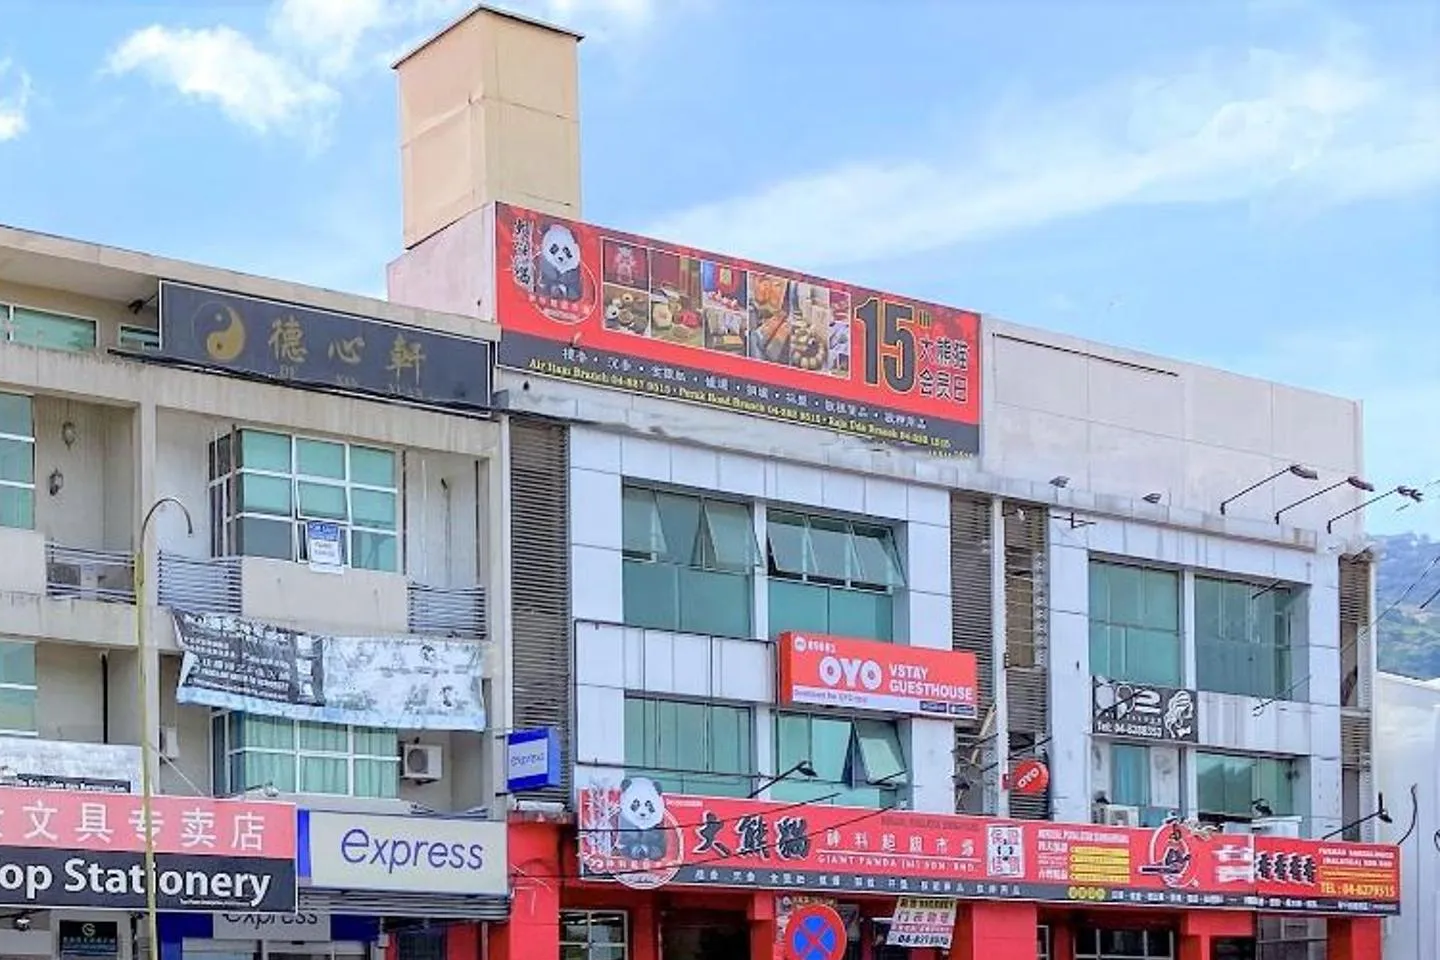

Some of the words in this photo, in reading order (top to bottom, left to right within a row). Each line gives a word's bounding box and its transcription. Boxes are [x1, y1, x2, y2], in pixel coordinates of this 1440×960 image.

[818, 655, 883, 691] OYO
[888, 663, 929, 681] VSTAY
[888, 679, 974, 701] GUESTHOUSE
[1017, 767, 1040, 789] OYO
[340, 828, 484, 875] express
[817, 853, 854, 865] GIANT
